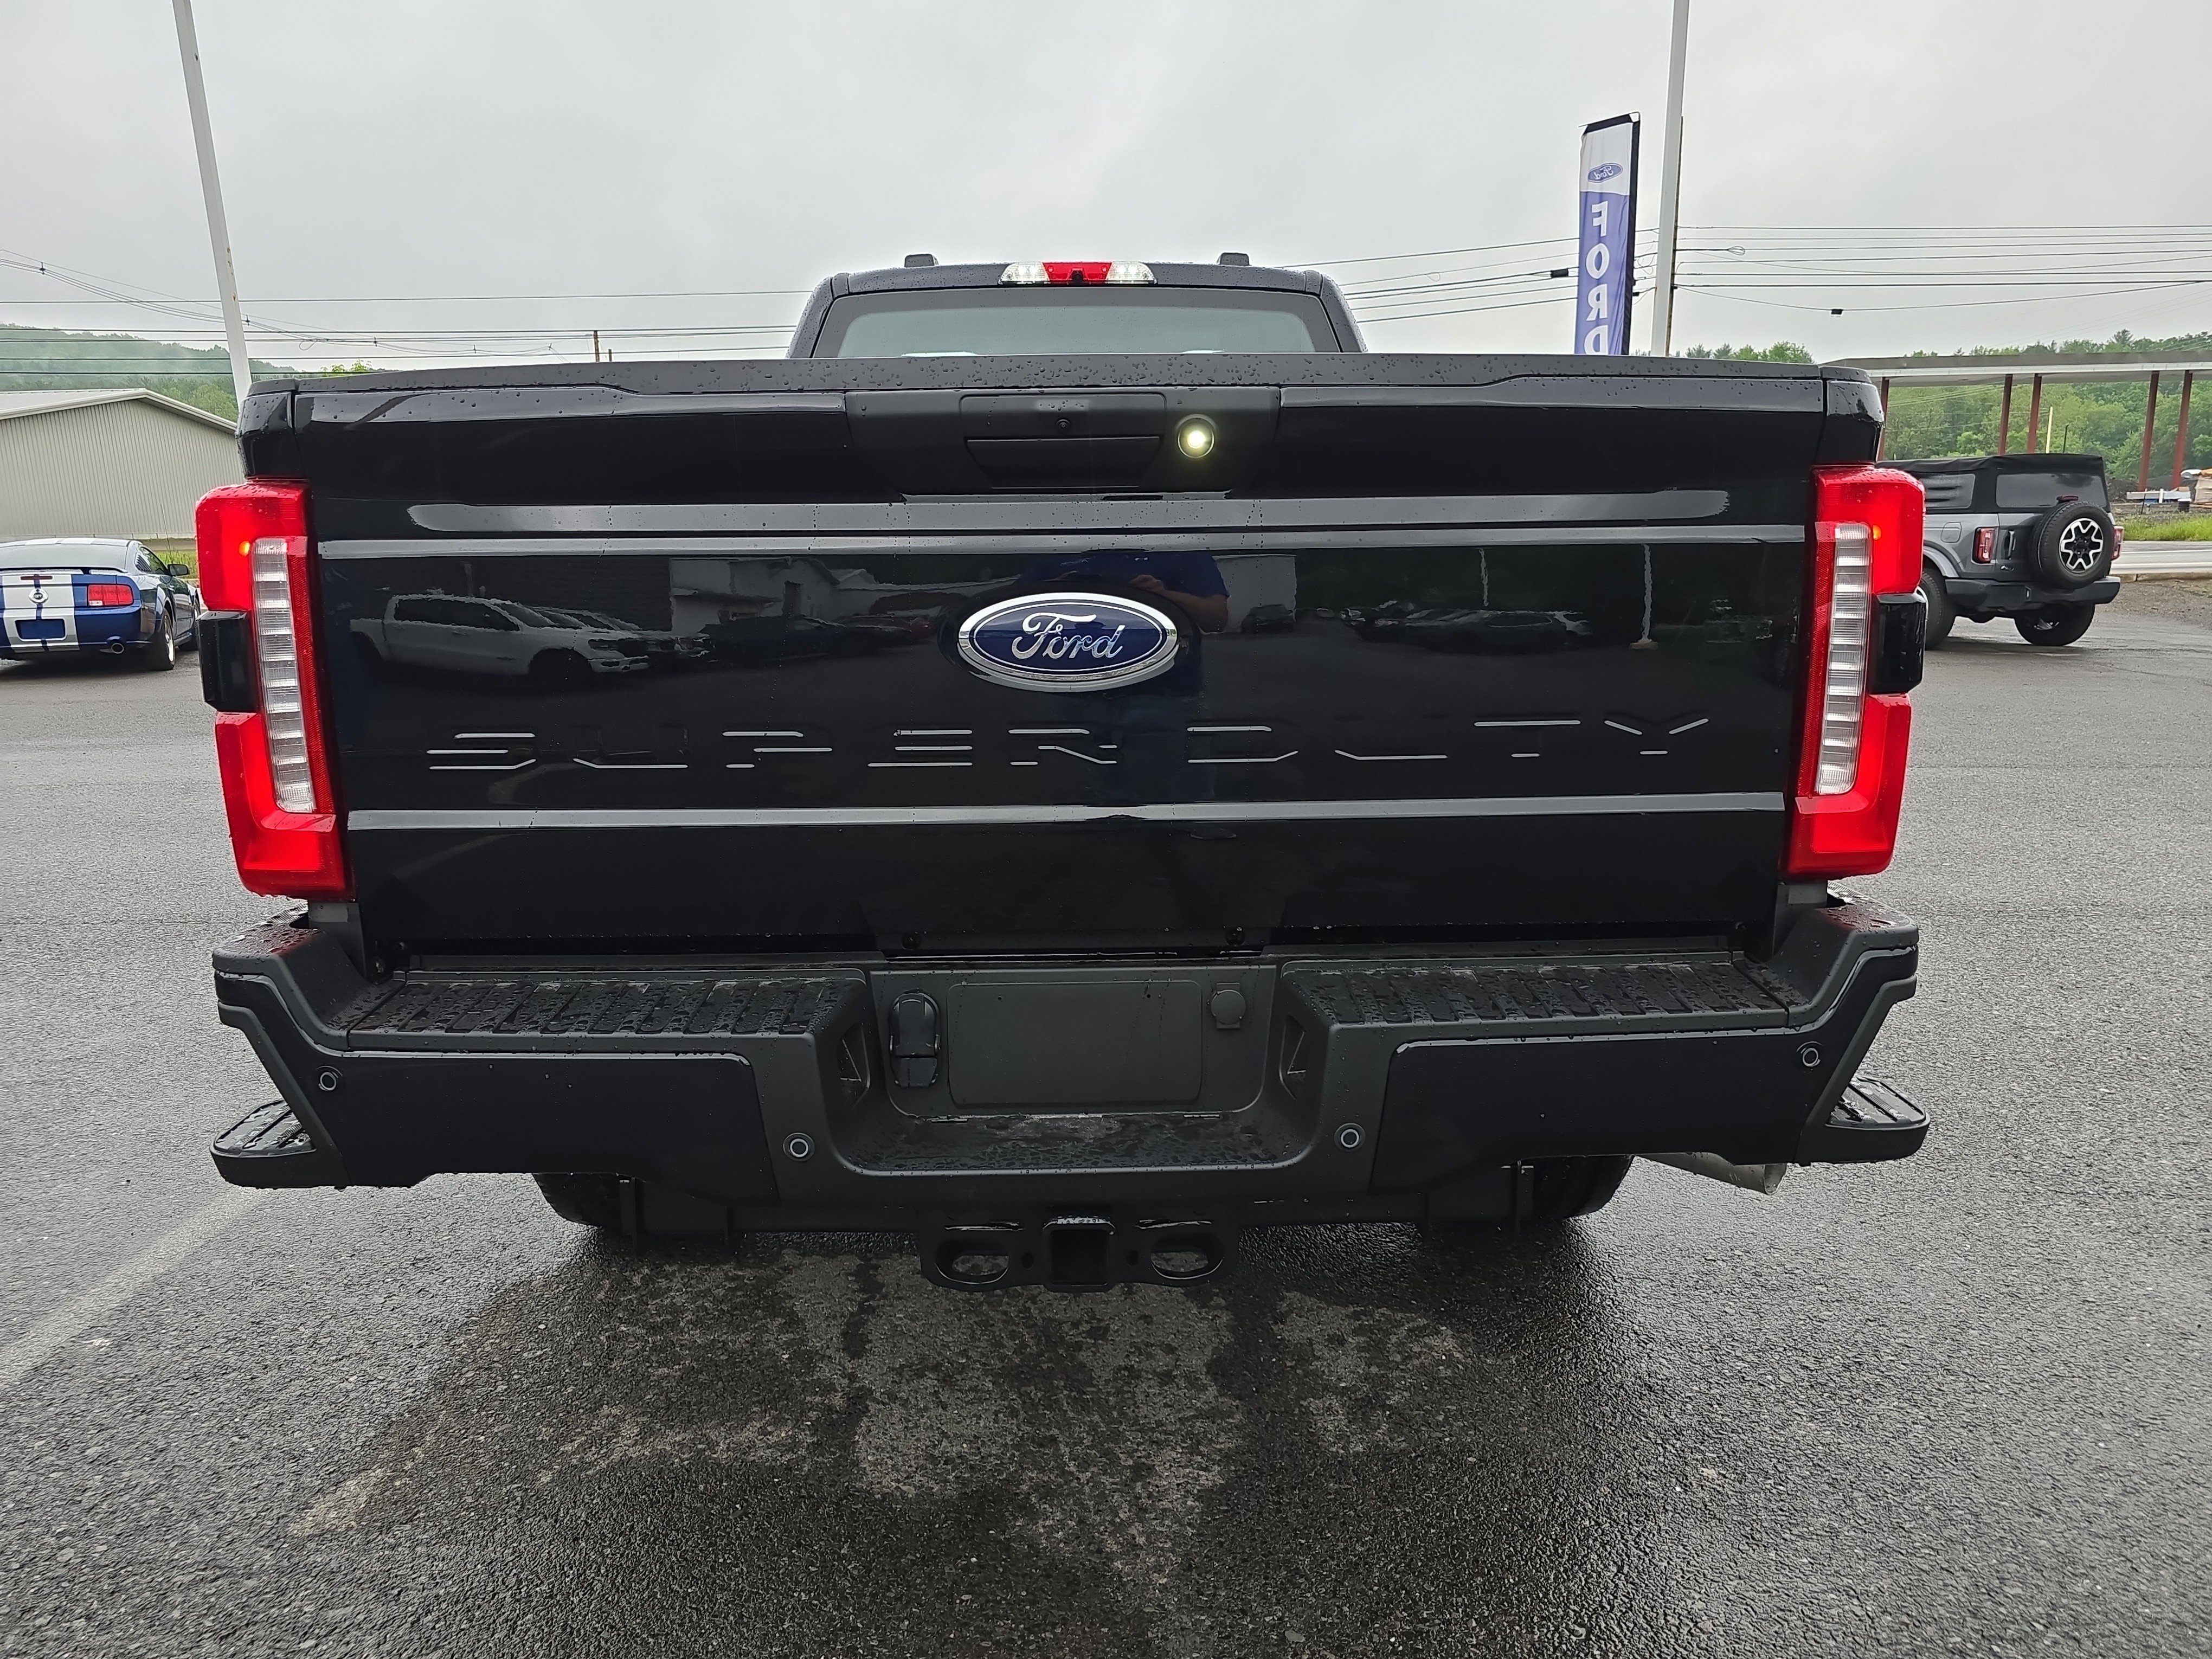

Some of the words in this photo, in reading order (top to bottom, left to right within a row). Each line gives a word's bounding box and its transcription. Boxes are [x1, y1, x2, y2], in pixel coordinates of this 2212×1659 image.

[1011, 612, 1126, 660] Ford
[426, 725, 1119, 771] SUPER
[1185, 714, 1711, 764] DUTY
